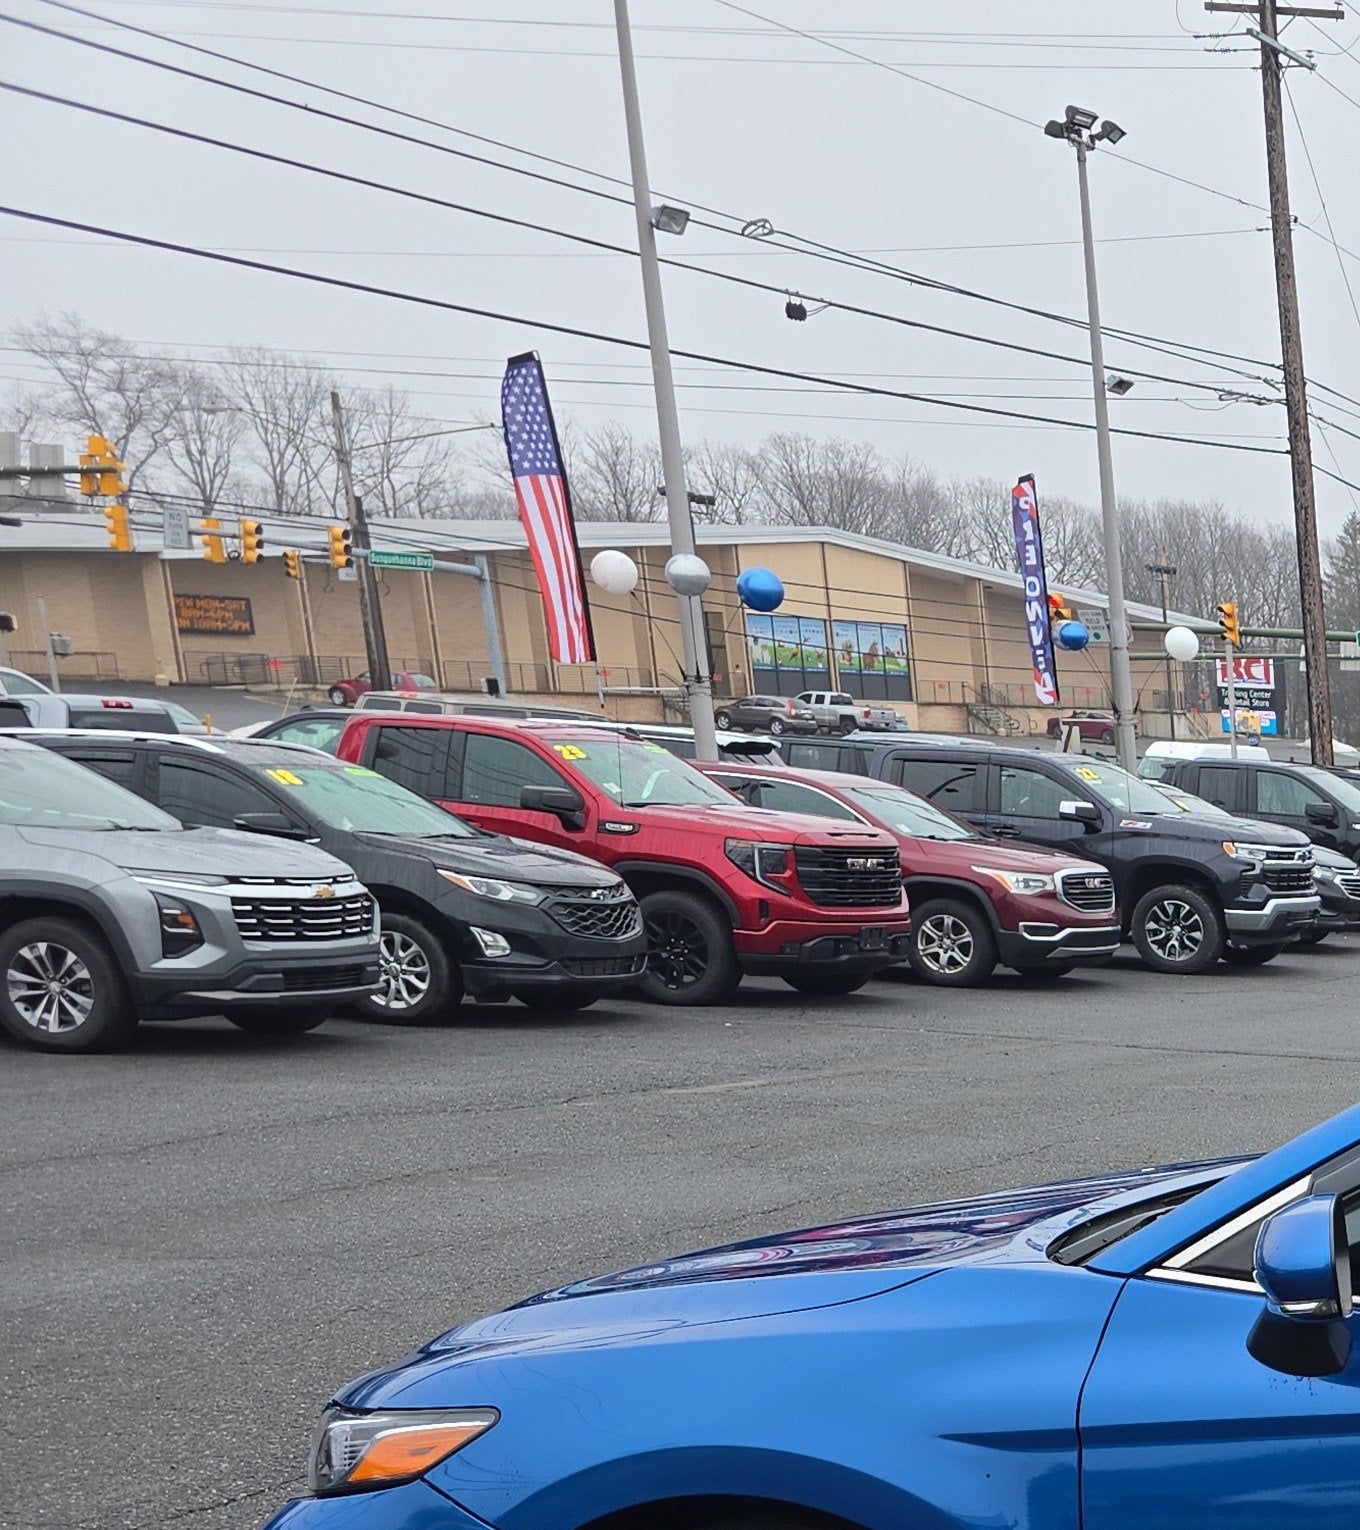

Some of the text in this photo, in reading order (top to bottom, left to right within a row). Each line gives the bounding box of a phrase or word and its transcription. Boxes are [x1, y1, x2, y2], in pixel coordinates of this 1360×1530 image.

[1221, 688, 1272, 698] Trning Center
[1251, 698, 1270, 707] Store
[553, 745, 588, 760] 23
[265, 768, 304, 786] 18
